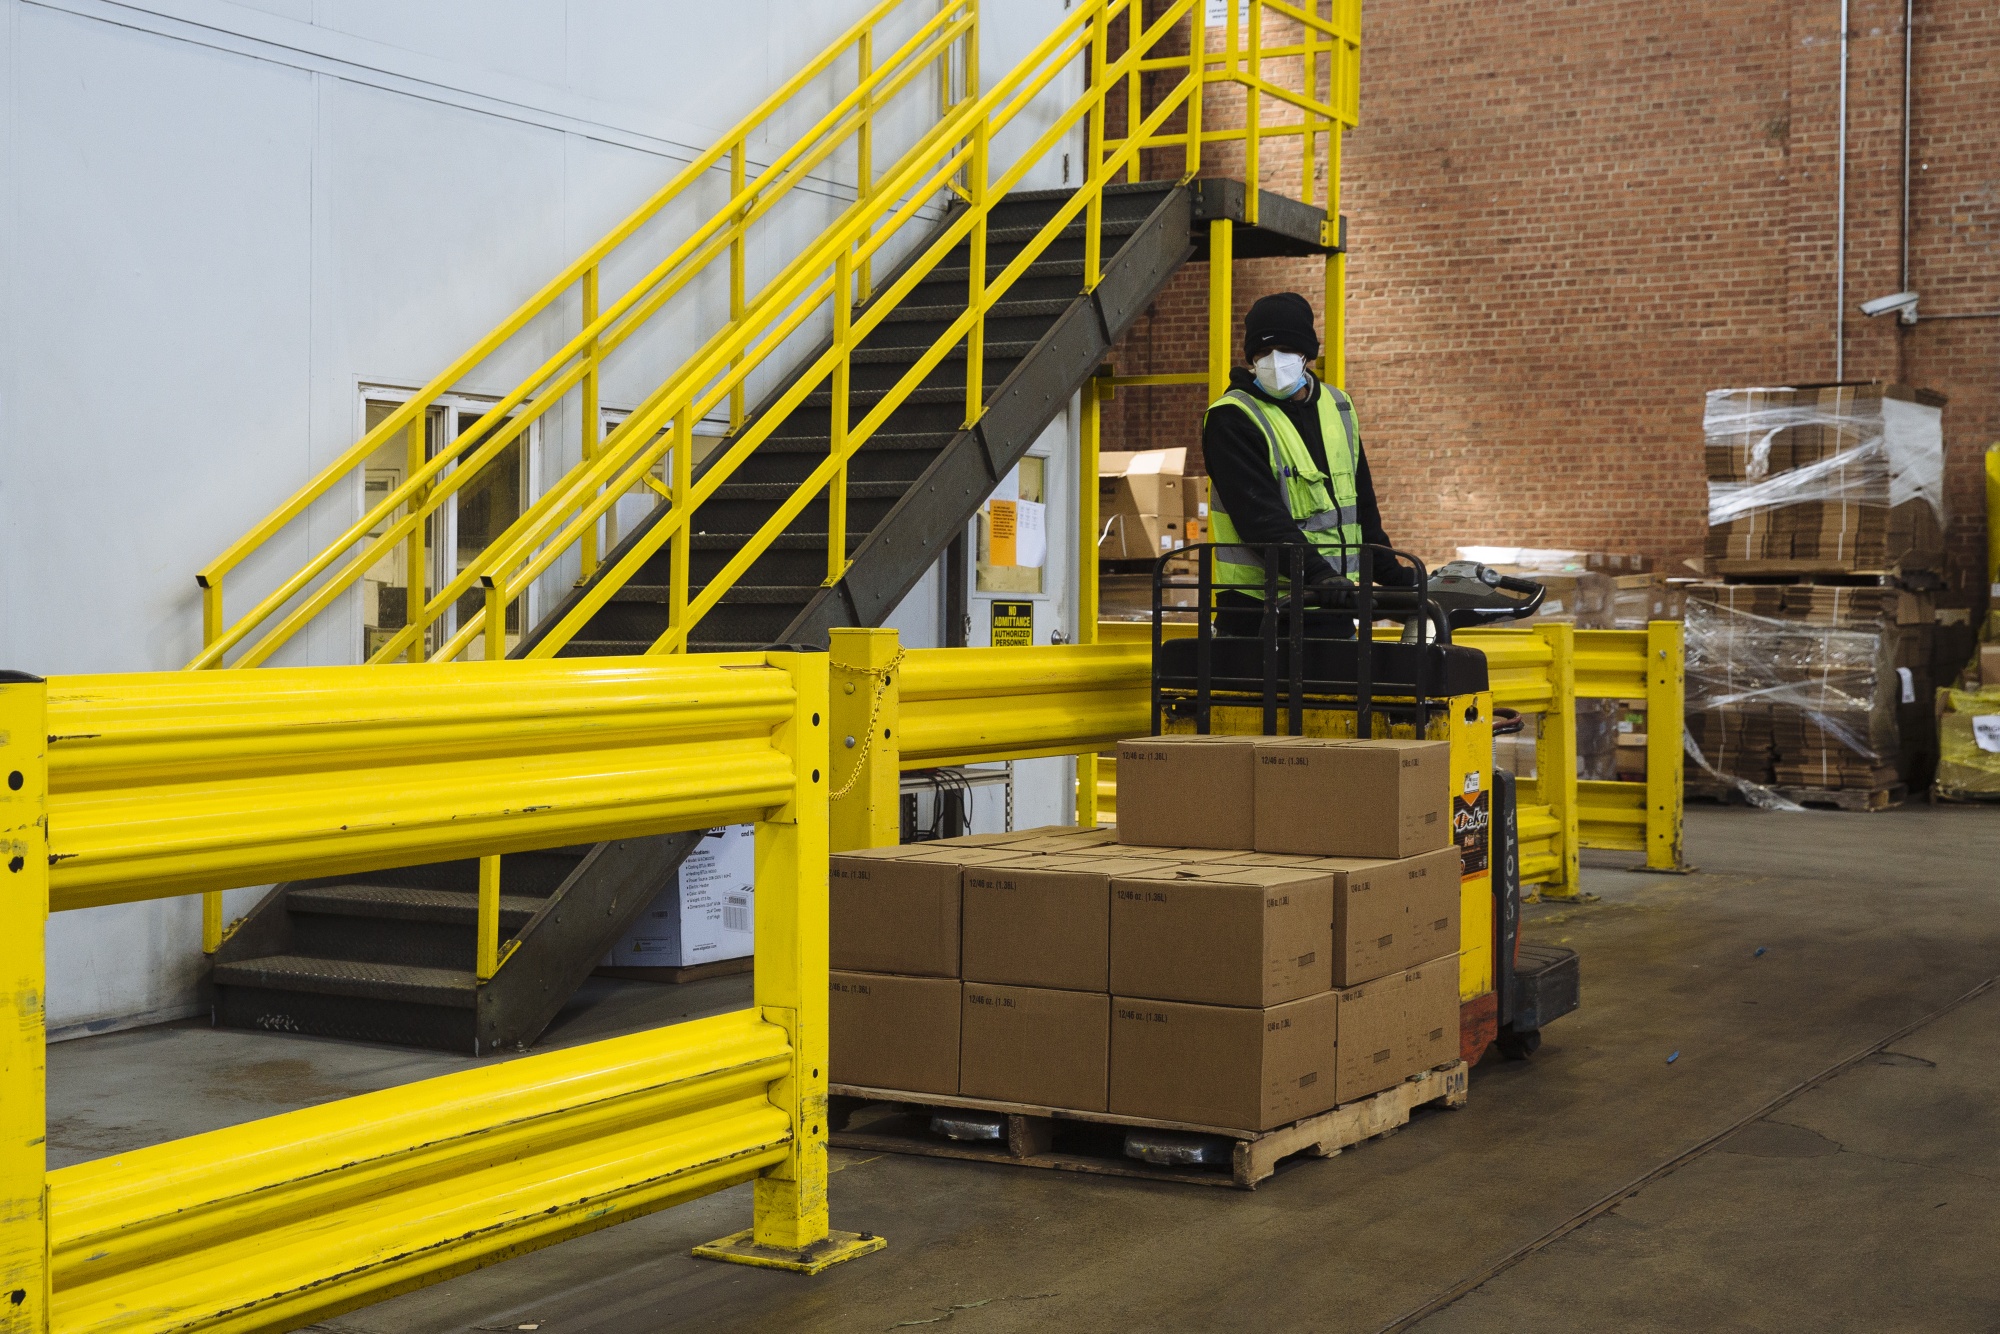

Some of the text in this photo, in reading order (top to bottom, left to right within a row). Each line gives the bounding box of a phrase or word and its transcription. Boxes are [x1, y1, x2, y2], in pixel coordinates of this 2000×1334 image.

[1008, 605, 1017, 616] NO
[994, 616, 1031, 627] ADMITTANCE
[994, 630, 1031, 638] AUTHORIZED
[995, 638, 1029, 647] PERSONNEL
[1122, 751, 1137, 760] 12/46
[1147, 752, 1168, 762] (1.36L)
[1261, 756, 1277, 765] 12/46
[1287, 756, 1309, 767] (1.36L)
[1455, 807, 1488, 831] Deka
[829, 869, 840, 878] 2/46
[969, 878, 1017, 891] 12/46 oz. (1.36L)
[1117, 890, 1167, 903] 12/46 oz. (1.36L)
[829, 982, 841, 992] 2/46
[968, 994, 1016, 1009] 12/46 oz. (1.36L)
[1118, 1009, 1168, 1025] 12/46 oz. (1.36L)
